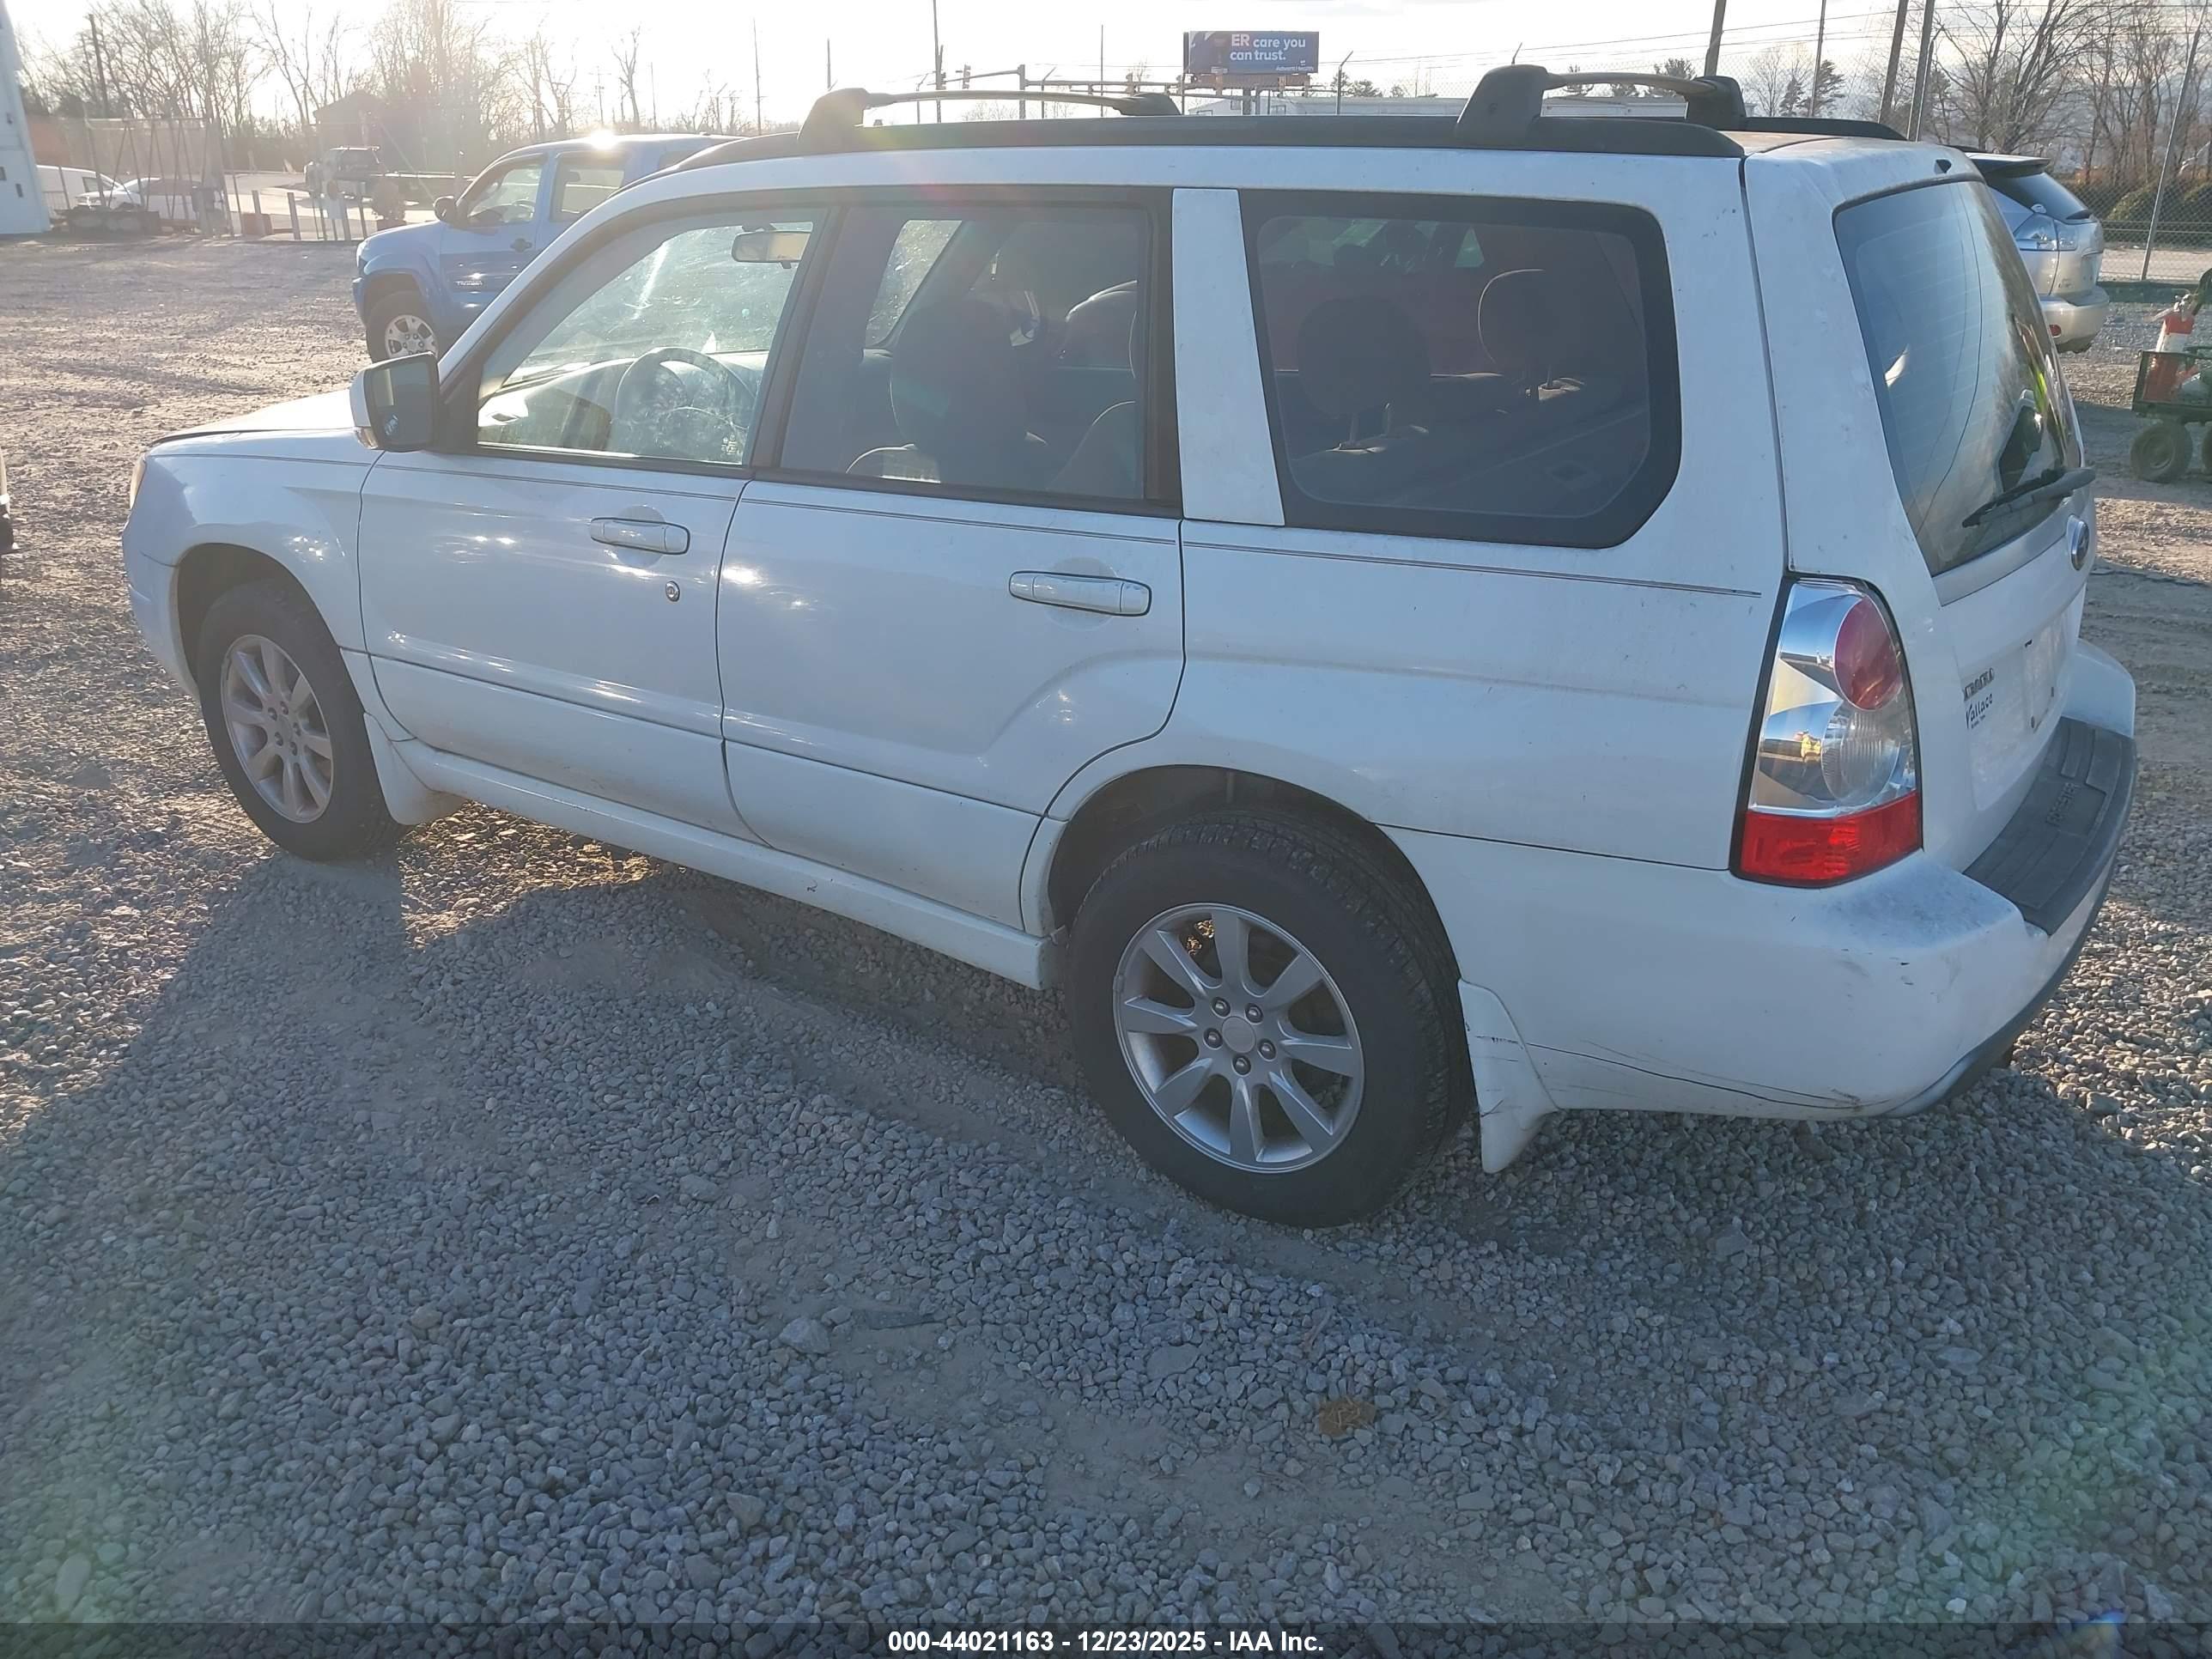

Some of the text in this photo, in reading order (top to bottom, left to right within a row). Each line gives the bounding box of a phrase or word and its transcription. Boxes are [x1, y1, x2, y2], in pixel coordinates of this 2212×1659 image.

[1231, 33, 1306, 51] ER care you
[1230, 49, 1286, 60] can trust.
